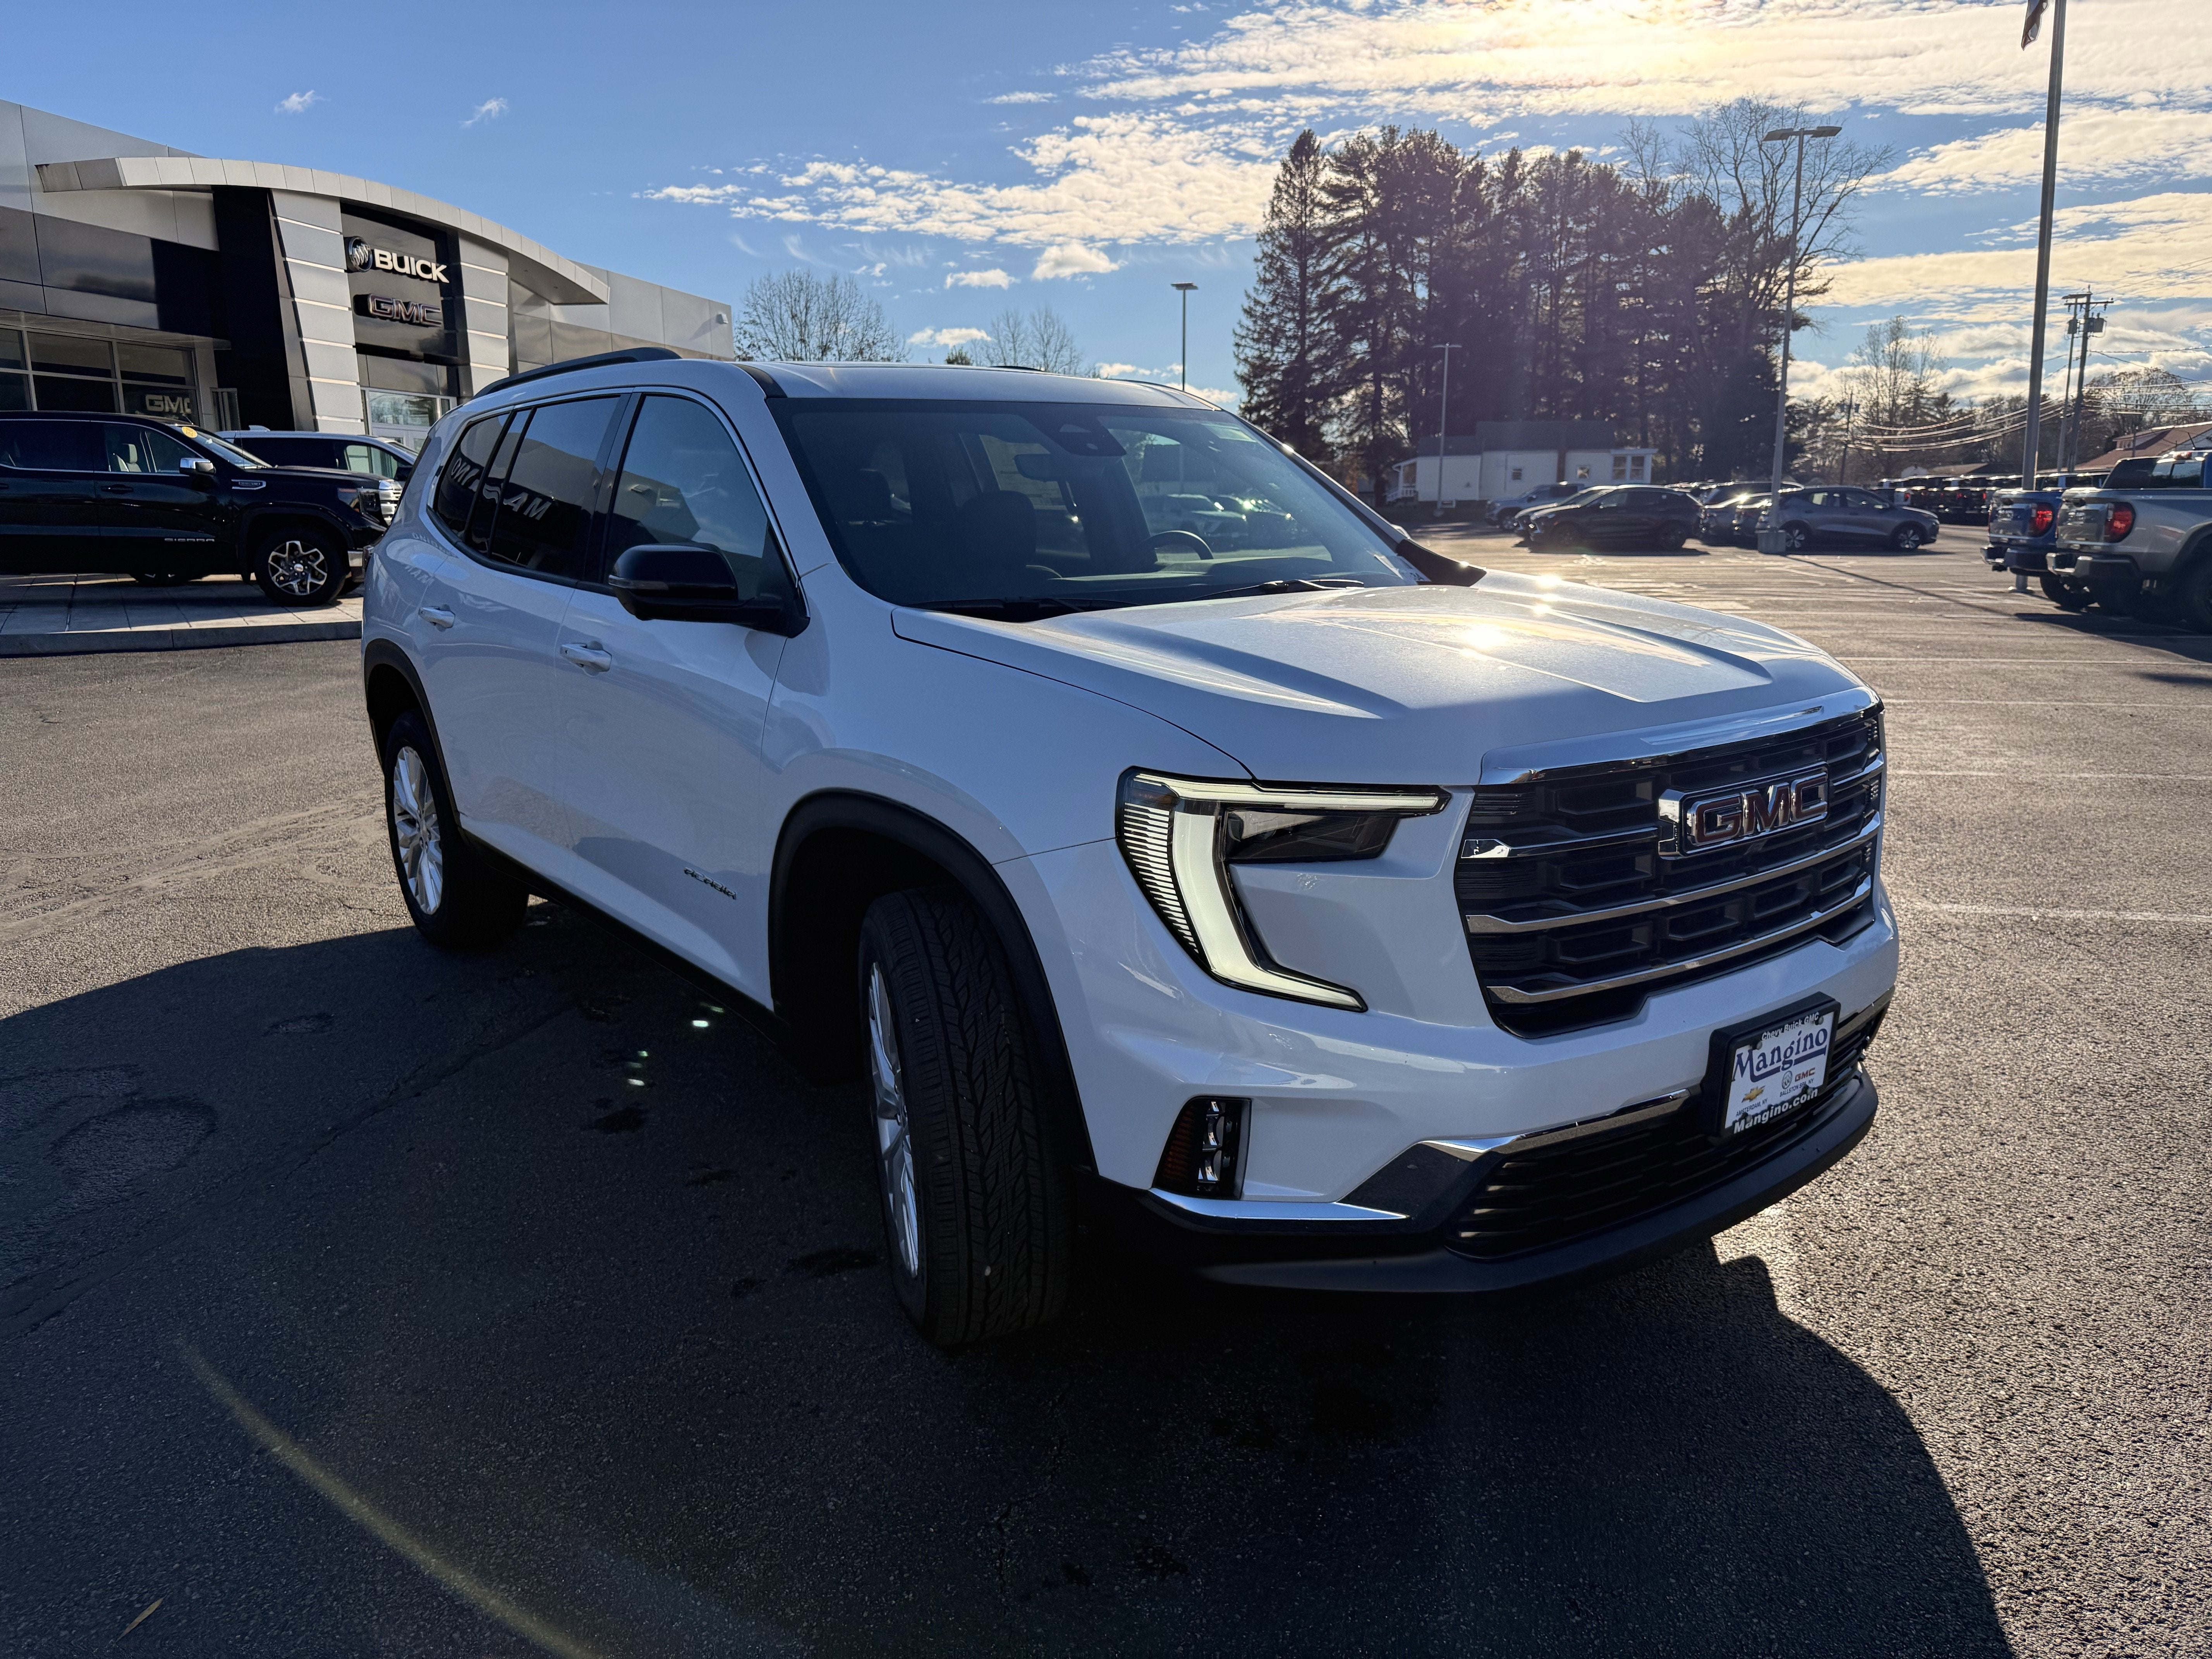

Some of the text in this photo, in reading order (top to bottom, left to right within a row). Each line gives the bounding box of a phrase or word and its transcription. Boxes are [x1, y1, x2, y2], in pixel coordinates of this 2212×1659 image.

[374, 249, 449, 283] BUICK
[369, 294, 442, 327] GMC
[1686, 772, 1828, 846] GMC
[1762, 1012, 1819, 1041] Chevy Buick GMC
[1732, 1028, 1828, 1082] Mangino
[1795, 1067, 1815, 1082] GMC
[1734, 1088, 1818, 1134] Mangino.com
